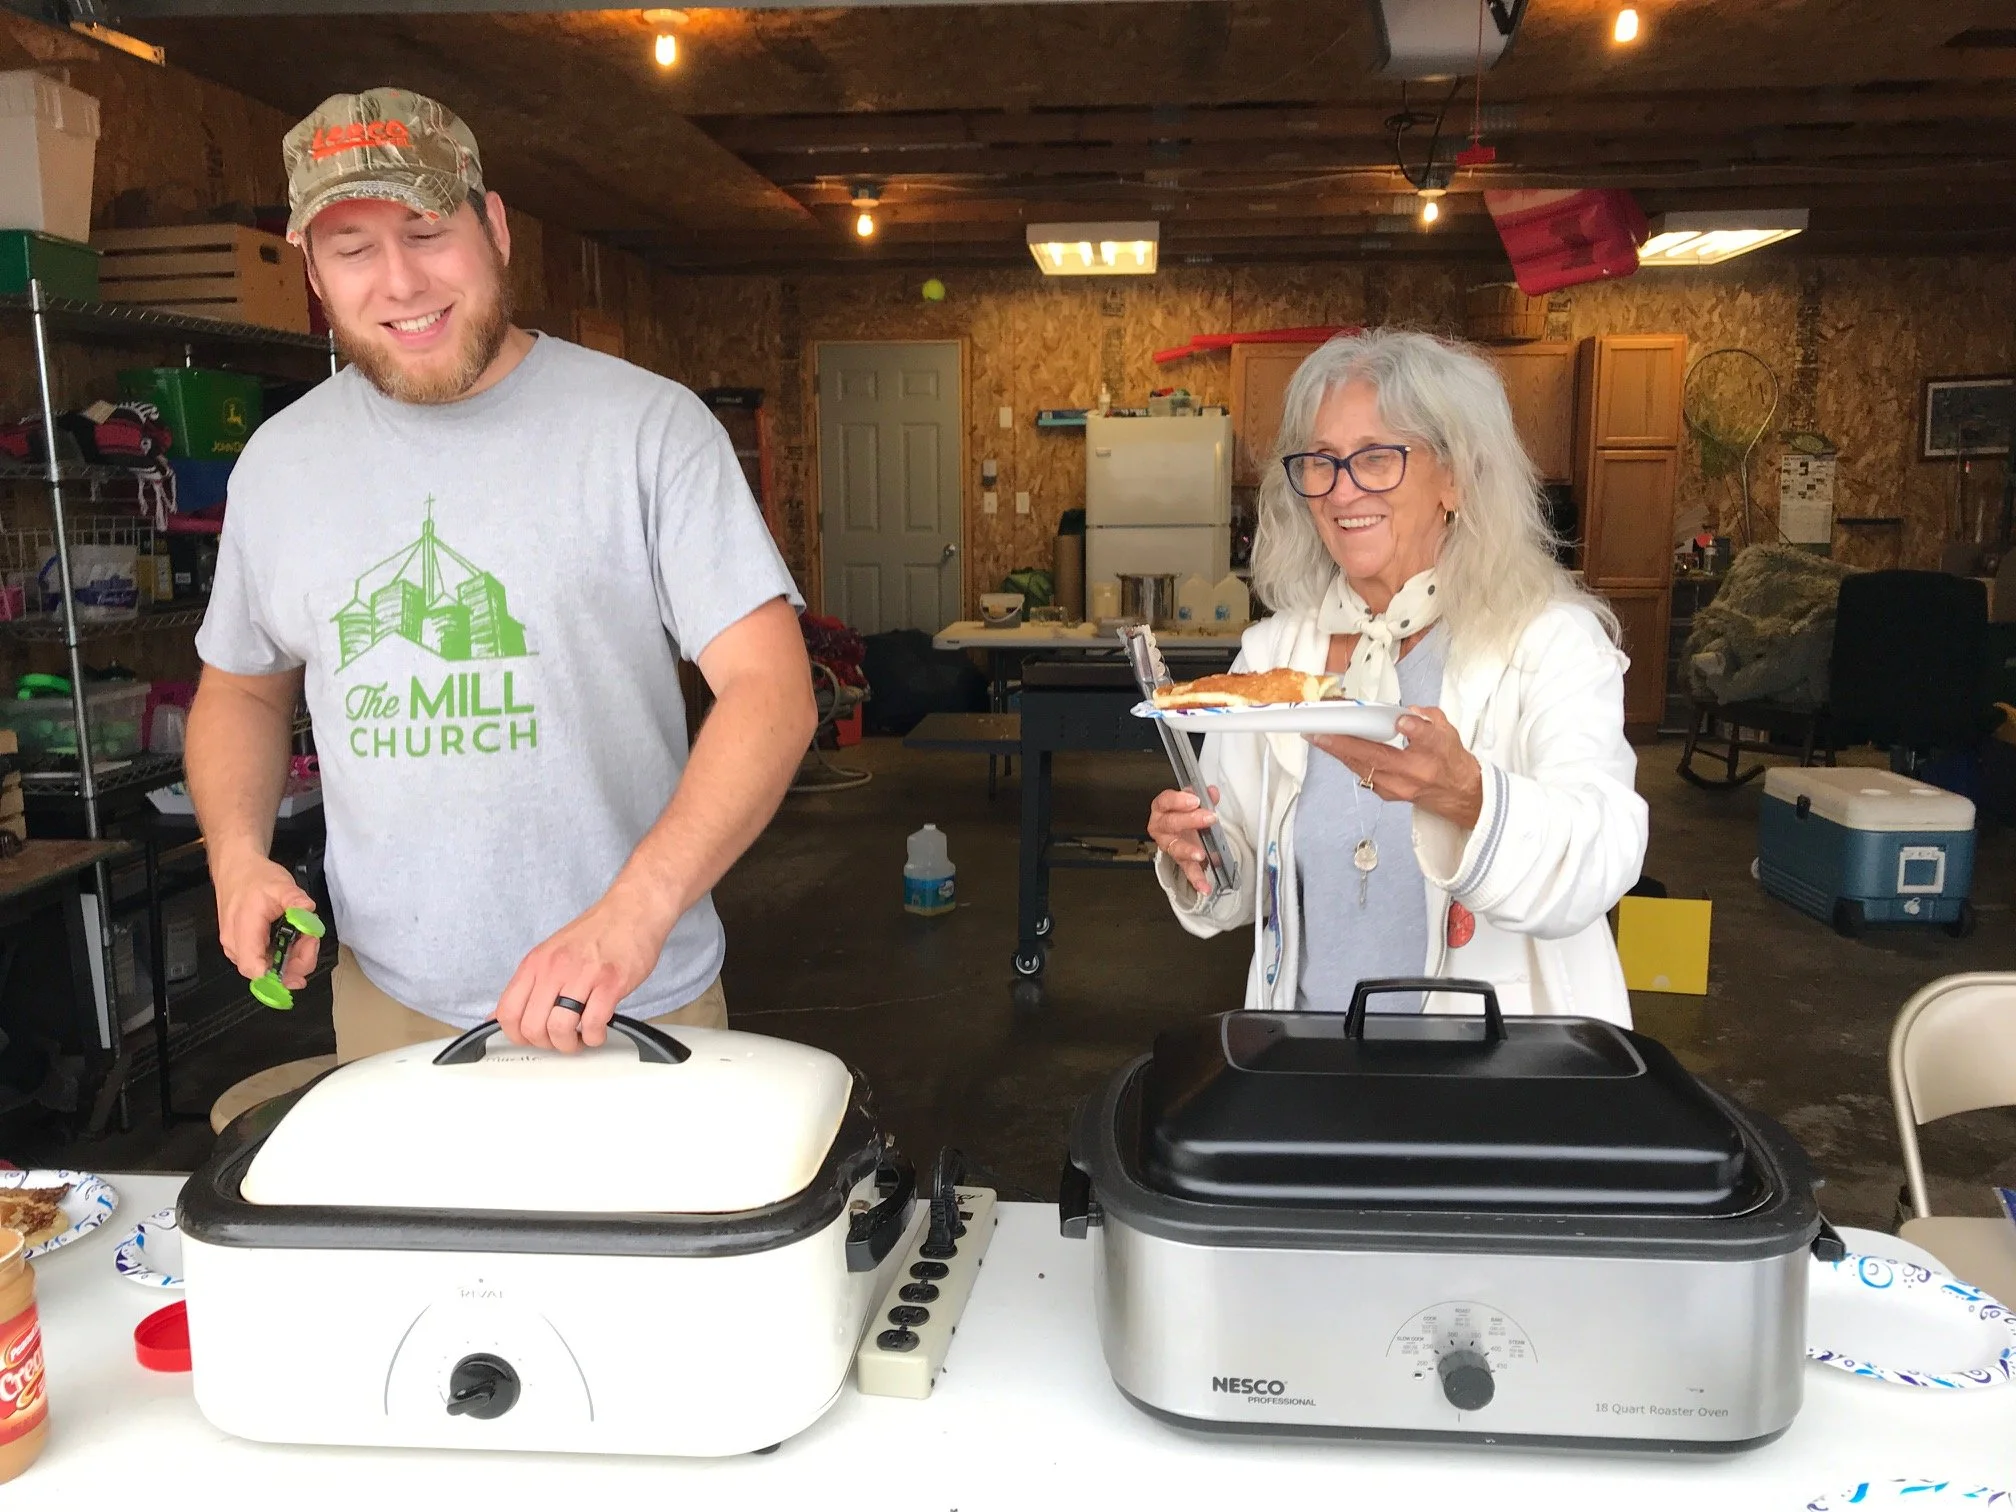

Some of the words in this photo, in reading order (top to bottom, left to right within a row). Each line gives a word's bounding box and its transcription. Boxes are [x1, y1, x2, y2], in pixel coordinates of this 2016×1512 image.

[346, 681, 400, 721] The
[410, 671, 535, 720] MILL
[350, 718, 537, 758] CHURCH
[1212, 1376, 1285, 1396] NESCO
[1247, 1396, 1316, 1406] PROFESSIONAL
[1595, 1403, 1609, 1413] 18
[1612, 1403, 1645, 1415] Quart
[1649, 1405, 1695, 1417] Roaster
[1698, 1407, 1729, 1417] Oven
